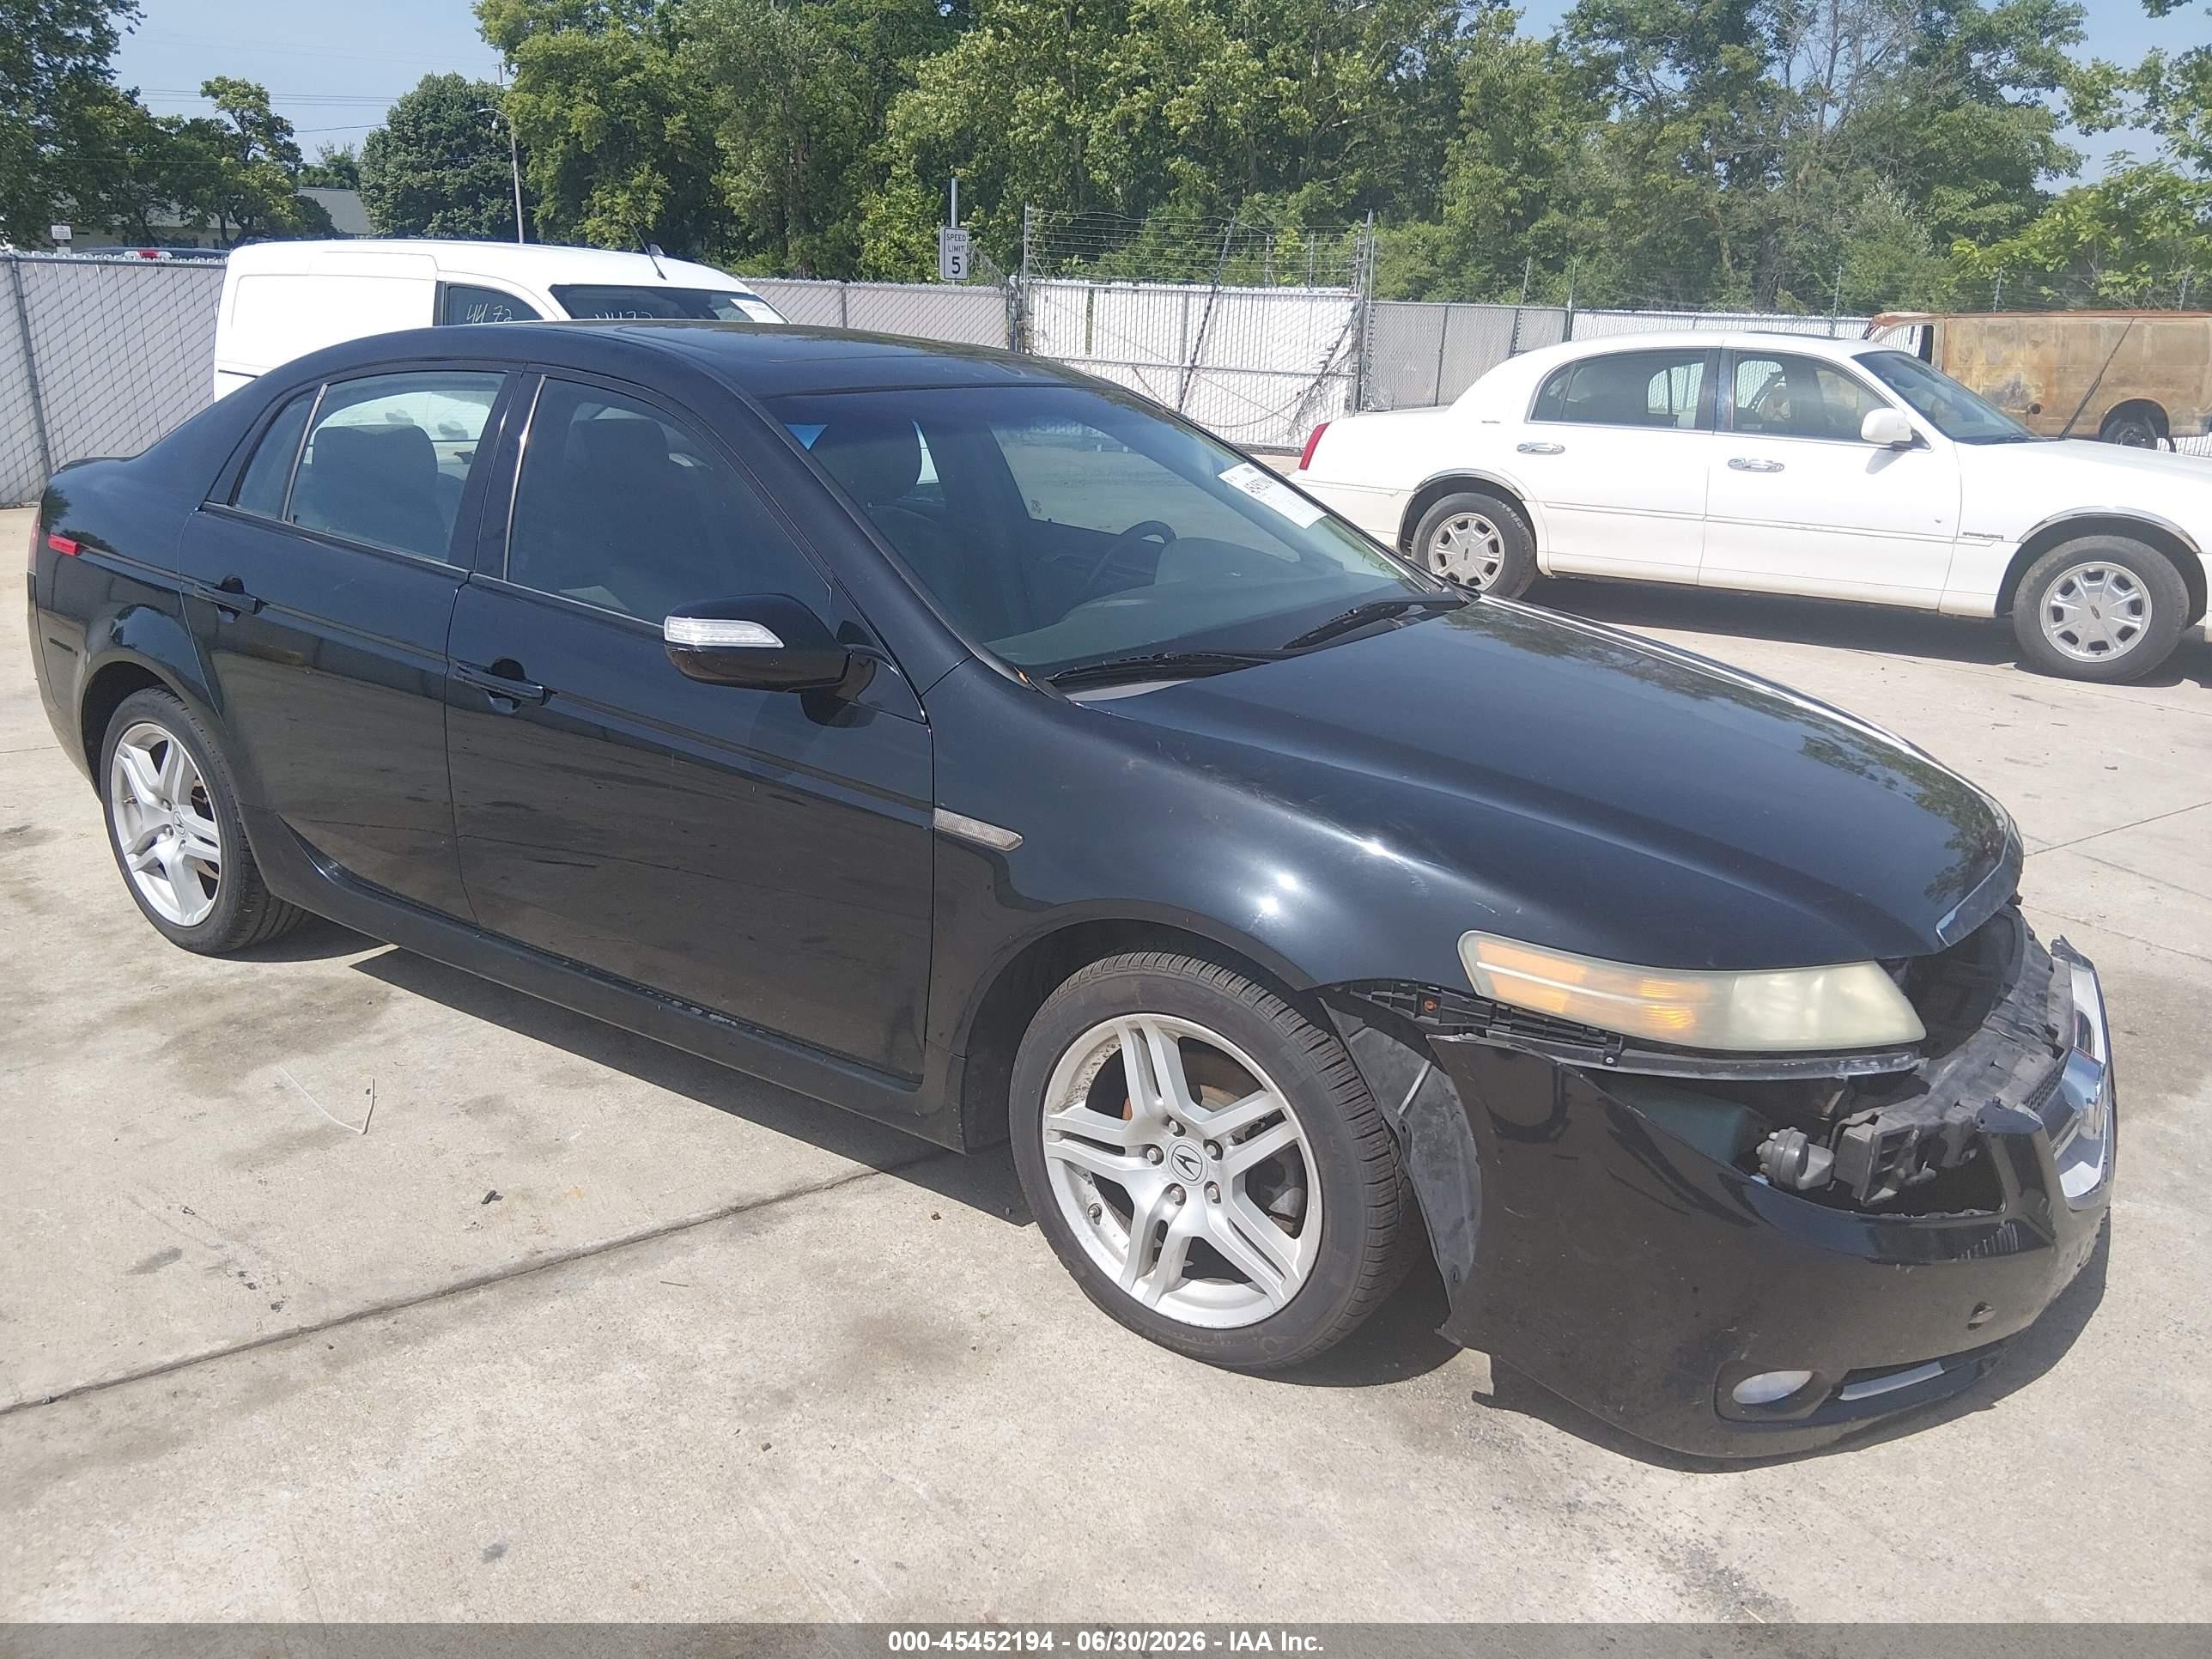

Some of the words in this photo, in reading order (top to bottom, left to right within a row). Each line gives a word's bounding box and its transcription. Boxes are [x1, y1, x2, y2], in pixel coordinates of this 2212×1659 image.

[946, 234, 966, 242] SPEED
[948, 245, 964, 253] LIMIT
[951, 256, 961, 274] 5
